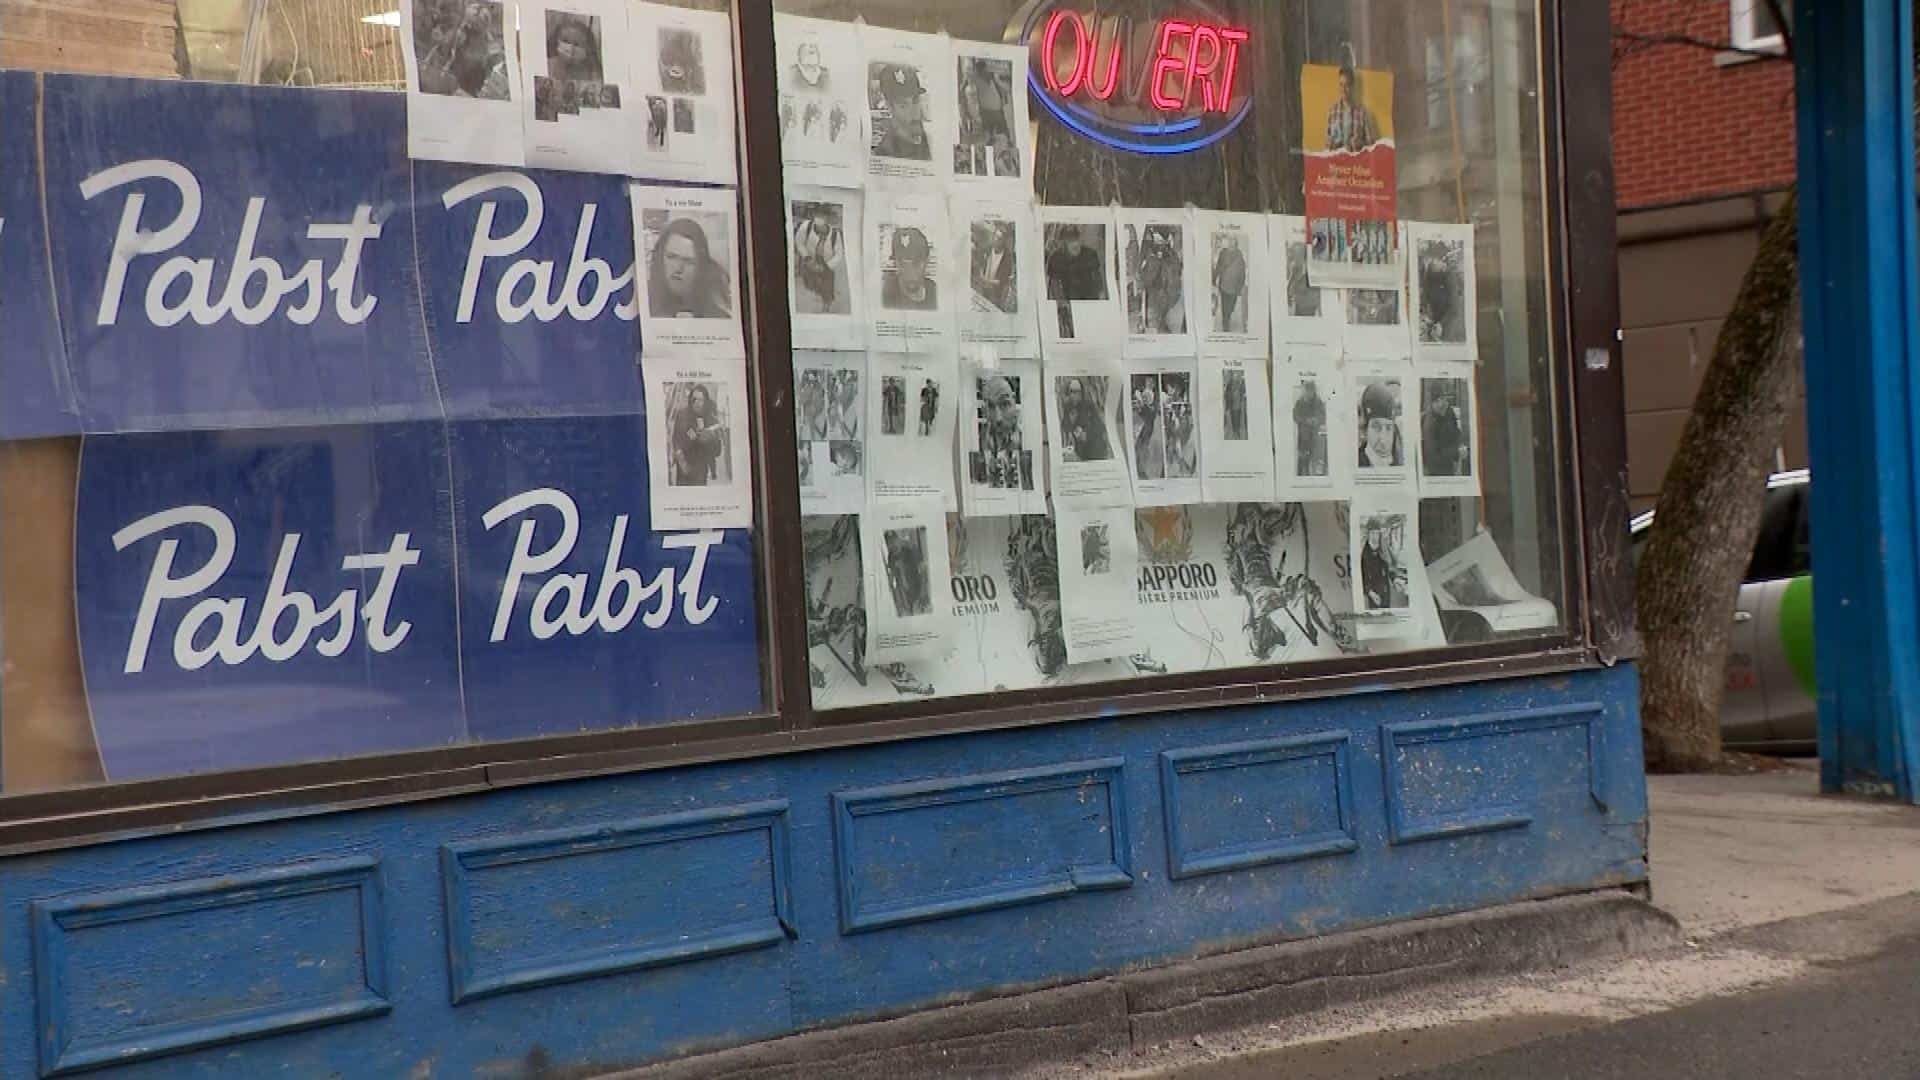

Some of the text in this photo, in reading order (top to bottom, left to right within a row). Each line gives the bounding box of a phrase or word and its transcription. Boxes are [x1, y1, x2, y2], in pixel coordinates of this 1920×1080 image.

[1042, 9, 1249, 112] OUVERT
[79, 159, 383, 327] Pabst
[111, 505, 421, 674] Pabst
[481, 488, 724, 642] Pabst
[1169, 589, 1220, 601] PREMIUM
